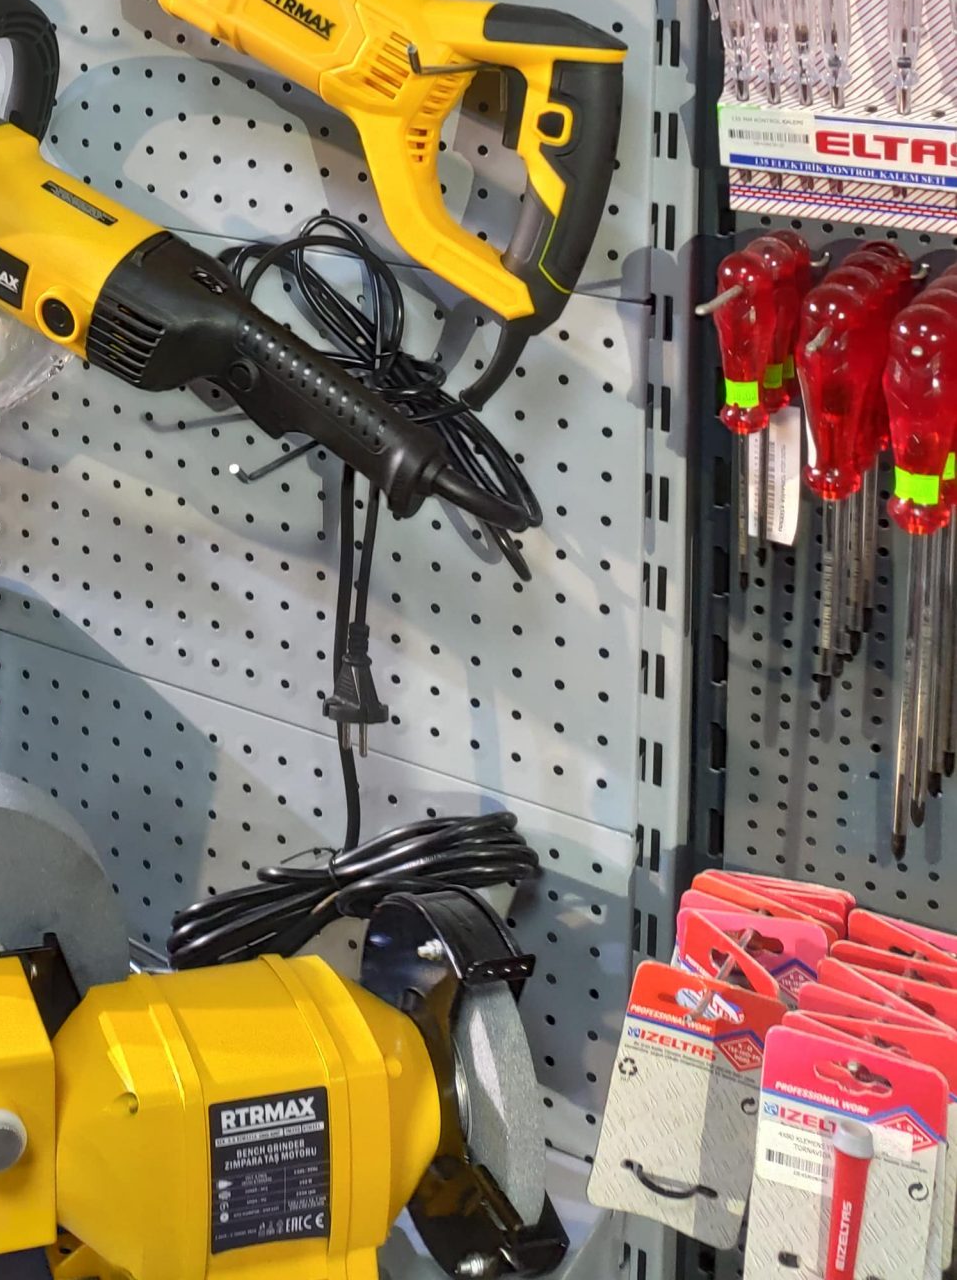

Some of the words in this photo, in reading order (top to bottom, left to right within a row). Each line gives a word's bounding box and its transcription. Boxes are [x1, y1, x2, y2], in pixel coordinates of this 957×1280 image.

[815, 129, 957, 167] ELTA
[770, 158, 824, 173] ELEKTRİK
[825, 165, 880, 178] KONTROL
[880, 170, 921, 183] KALEM
[639, 1028, 716, 1062] IZELTAS
[220, 1095, 317, 1131] RTRMAX
[775, 1080, 840, 1108] PROFESSIONAL
[842, 1100, 870, 1116] WORK
[780, 1106, 838, 1134] IZELT
[224, 1155, 263, 1172] ZIMPARA
[281, 1145, 318, 1161] MOTORU
[236, 1146, 266, 1160] BENCH
[267, 1138, 305, 1154] GRINDER
